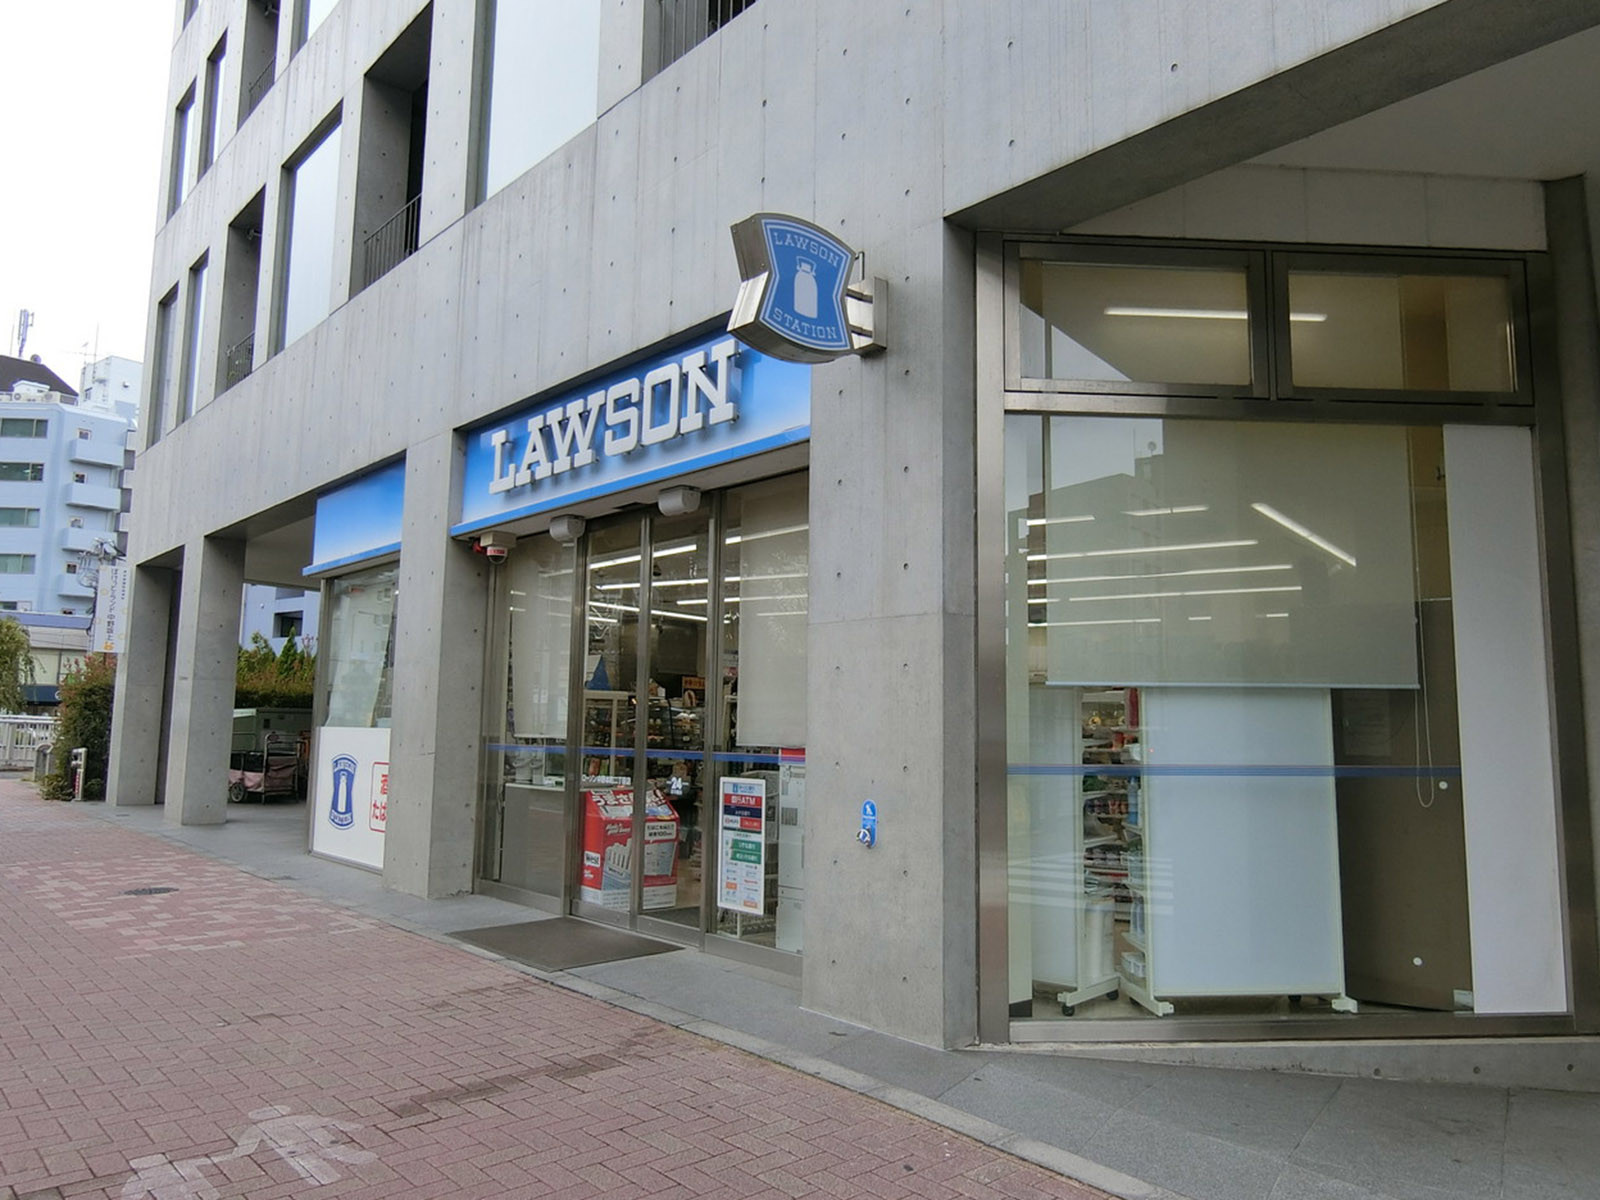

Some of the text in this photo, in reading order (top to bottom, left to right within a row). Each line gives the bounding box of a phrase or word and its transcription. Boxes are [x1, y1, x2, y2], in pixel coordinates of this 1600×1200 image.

[773, 231, 840, 268] LAWSON
[772, 307, 838, 341] STATION
[489, 338, 740, 494] LAWSON
